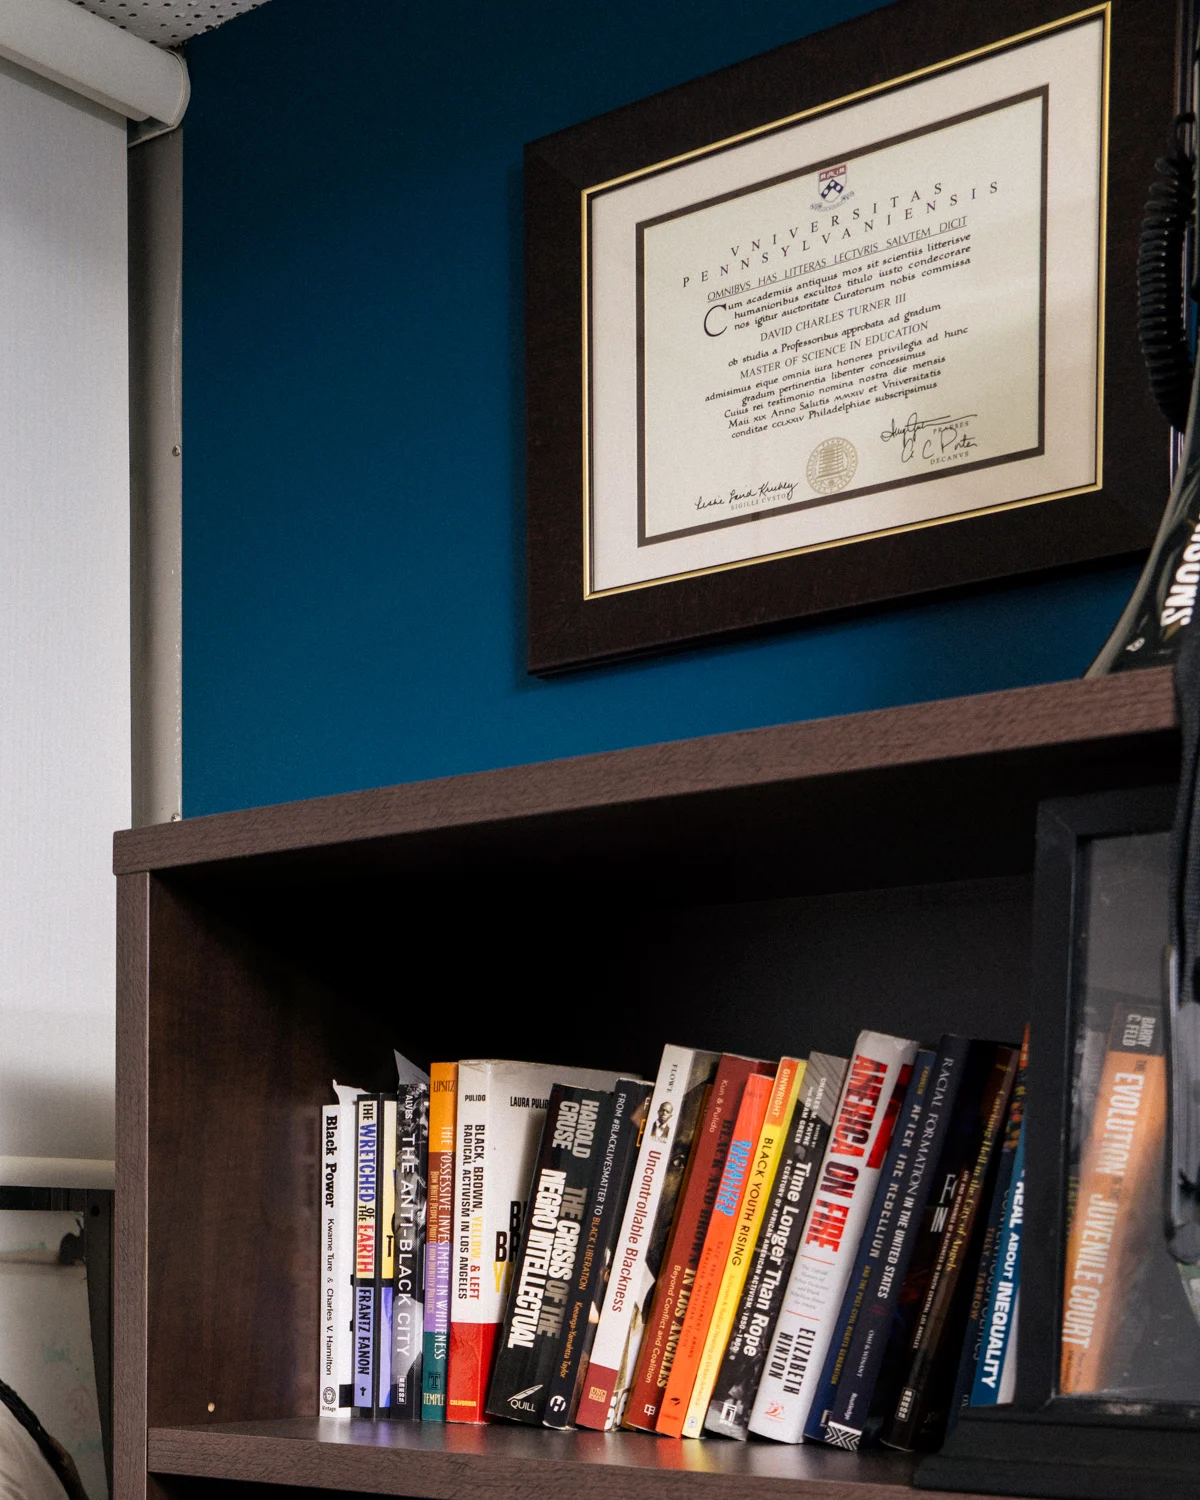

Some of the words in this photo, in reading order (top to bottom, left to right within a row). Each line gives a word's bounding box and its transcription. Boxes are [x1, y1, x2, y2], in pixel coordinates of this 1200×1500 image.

[683, 182, 998, 287] PENNSYLVANIENSIS
[731, 183, 942, 256] VNIVERSITAS
[708, 281, 751, 302] OMNIBVS
[758, 273, 778, 287] HAS
[784, 259, 827, 278] LITTERAS
[834, 243, 879, 264] LECTVRIS
[886, 228, 931, 248] SALVTEM
[939, 216, 968, 232] DICIT
[746, 284, 792, 304] academiis
[796, 274, 838, 290] antiquus
[842, 265, 863, 277] mos
[867, 260, 880, 270] sit
[882, 248, 923, 265] scientiis
[927, 233, 971, 252] litterisve
[760, 325, 793, 342] DAVID
[795, 311, 844, 332] CHARLES
[847, 297, 891, 318] TURNER
[895, 293, 906, 305] III
[740, 360, 781, 380] MASTER
[784, 355, 799, 368] OF
[801, 343, 847, 363] SCIENCE
[850, 339, 861, 350] IN
[865, 321, 928, 346] EDUCATION
[362, 1103, 373, 1120] THE
[552, 1101, 580, 1150] CRUSE
[572, 1099, 600, 1158] HAROLD
[830, 1054, 888, 1157] AMERICA
[1096, 1072, 1145, 1176] EVOLUTION
[326, 1115, 337, 1156] Black
[401, 1134, 415, 1173] THE
[755, 1137, 773, 1178] BLACK
[325, 1162, 337, 1208] Power
[359, 1123, 376, 1202] WRETCHED
[787, 1162, 812, 1202] Time
[820, 1161, 859, 1199] ON
[358, 1205, 367, 1221] THE
[366, 1207, 375, 1219] OF
[531, 1168, 567, 1230] NEGRO
[560, 1187, 588, 1219] THE
[628, 1150, 662, 1244] Uncontrollable
[743, 1183, 761, 1222] YOUTH
[356, 1225, 374, 1272] EARTH
[398, 1180, 414, 1306] ANTI-BLACK
[548, 1220, 580, 1280] CRISIS
[732, 1224, 750, 1266] RISING
[770, 1205, 799, 1265] Longer
[805, 1199, 850, 1252] FIRE
[1074, 1193, 1118, 1284] JUVENILE
[612, 1247, 638, 1312] Blackness
[1003, 1231, 1020, 1279] ABOUT
[358, 1289, 371, 1332] FRANTZ
[508, 1229, 555, 1348] INTELLECTUAL
[545, 1280, 569, 1303] OF
[756, 1270, 782, 1310] Than
[397, 1313, 411, 1357] CITY
[537, 1304, 565, 1338] THE
[743, 1312, 770, 1357] Rope
[981, 1281, 1014, 1389] INEQUALITY
[1062, 1285, 1100, 1348] COURT
[358, 1336, 370, 1375] FANON
[768, 1331, 793, 1380] HINTON
[783, 1328, 816, 1395] ELIZABETH
